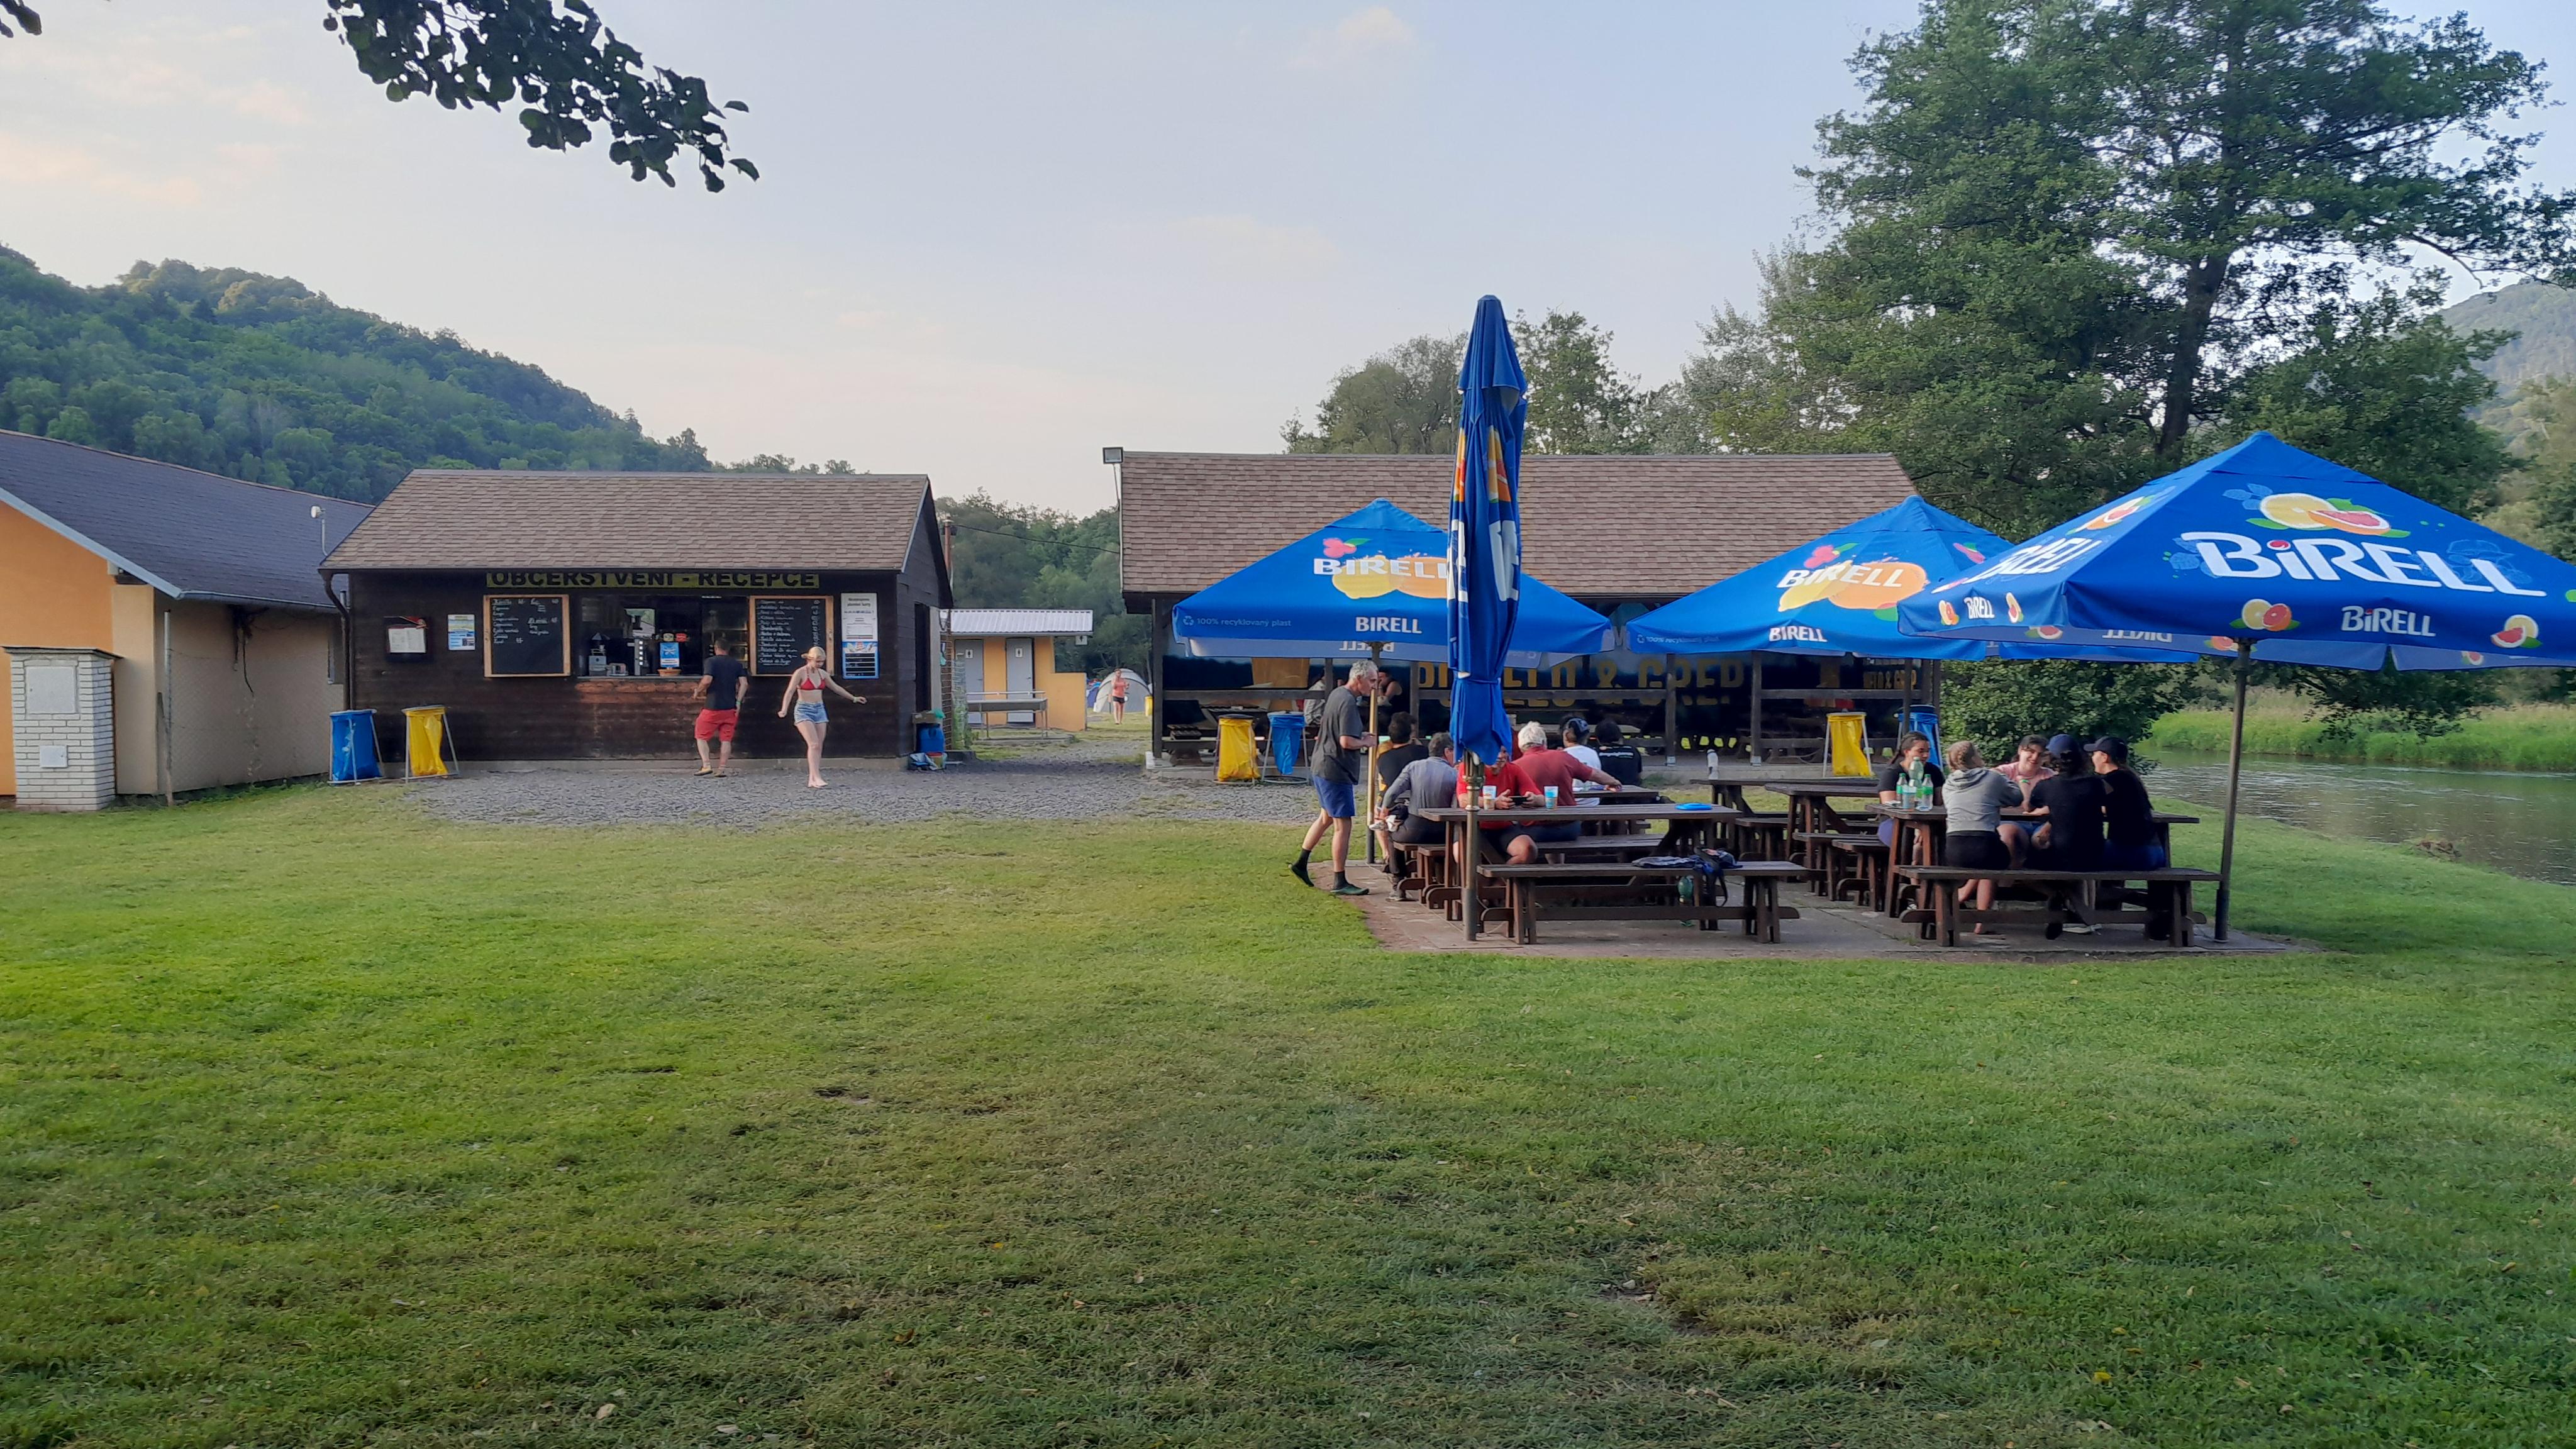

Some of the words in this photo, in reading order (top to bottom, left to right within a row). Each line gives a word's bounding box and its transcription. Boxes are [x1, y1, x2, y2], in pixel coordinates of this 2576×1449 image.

[698, 573, 814, 586] RECEPCE
[1775, 563, 1904, 588] BIRELL
[1355, 616, 1423, 634] BIRELL
[1768, 625, 1828, 642] BIRELL
